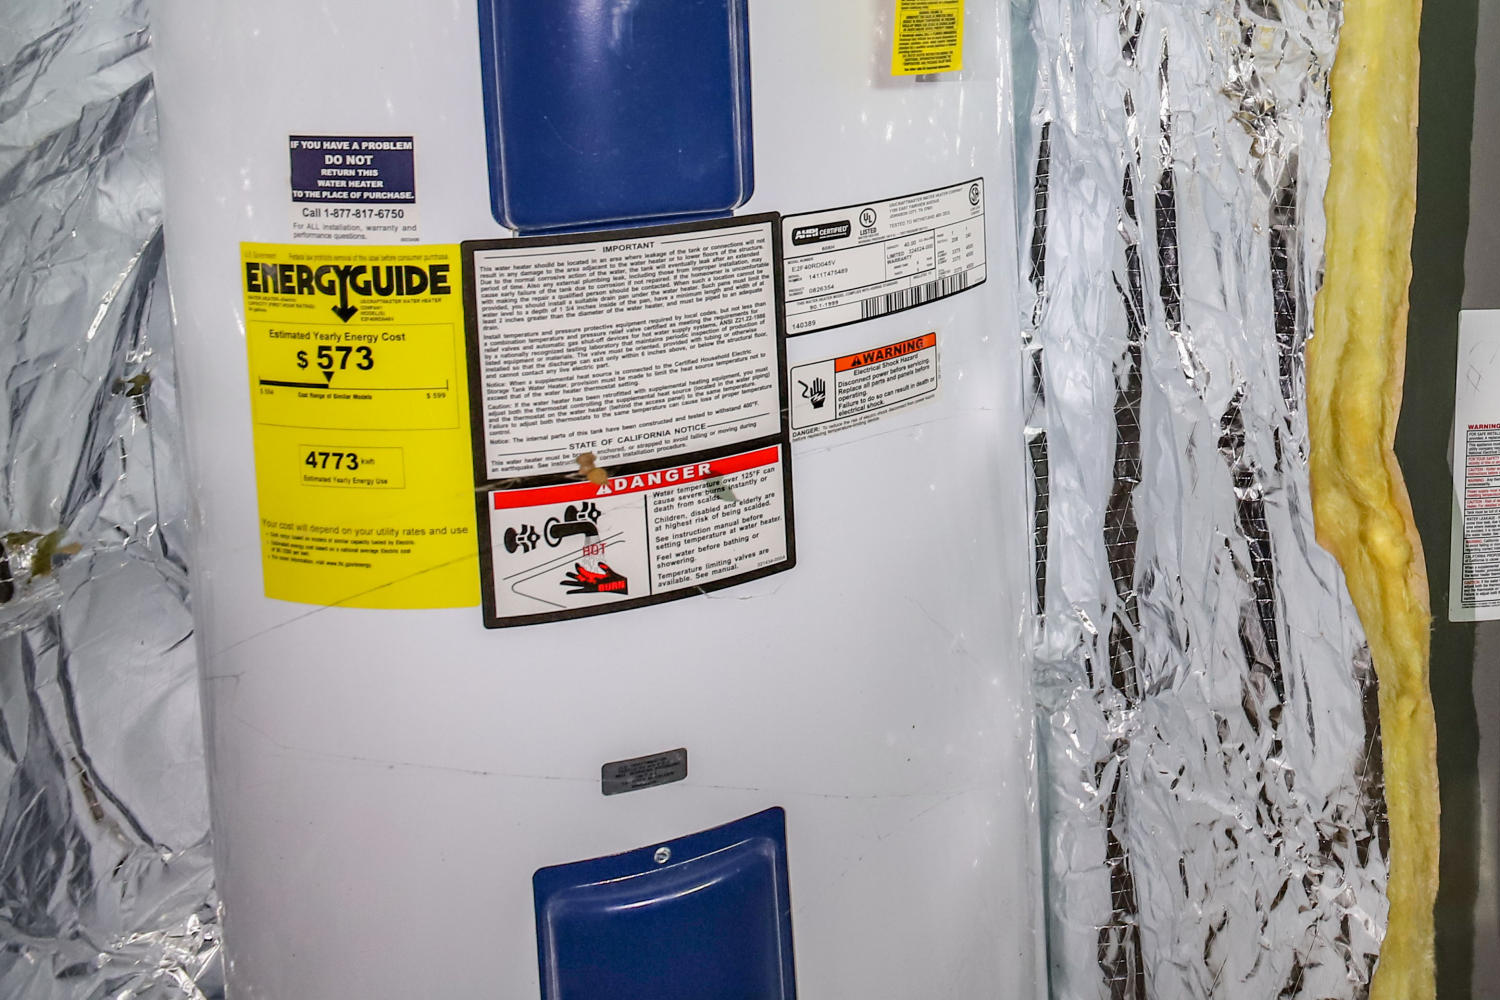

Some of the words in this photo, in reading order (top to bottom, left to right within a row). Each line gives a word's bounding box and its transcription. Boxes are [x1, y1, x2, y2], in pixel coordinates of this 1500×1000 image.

[291, 141, 299, 149] IF
[301, 141, 321, 149] YOU
[323, 141, 349, 149] HAVE
[362, 141, 412, 150] PROBLEM
[325, 155, 342, 165] DO
[347, 155, 373, 165] NOT
[293, 190, 303, 198] TO
[350, 191, 362, 199] OF
[363, 191, 415, 199] PURCHASE.
[349, 180, 383, 188] HEATER
[302, 208, 321, 218] Call
[324, 208, 404, 219] 1-877-817-6750
[307, 223, 320, 231] ALL
[366, 224, 398, 232] warranty
[602, 242, 655, 253] IMPORTANT
[246, 263, 451, 296] ENERGYGUIDE
[269, 329, 310, 339] Estimated
[313, 331, 341, 342] Yearly
[344, 332, 378, 343] Energy
[382, 332, 405, 341] Cost
[297, 351, 309, 370] $
[317, 346, 374, 370] 573
[863, 339, 923, 363] WARNING
[838, 376, 871, 387] Disconnect
[872, 371, 888, 381] power
[890, 367, 906, 375] before
[908, 359, 929, 371] servicing
[854, 364, 881, 376] Electrical
[882, 359, 899, 369] Shock
[900, 353, 918, 363] Hazard
[838, 385, 862, 395] Replace
[871, 378, 885, 387] parts
[898, 370, 914, 380] panels
[915, 365, 929, 373] before
[838, 398, 858, 409] Failure
[894, 385, 909, 394] result
[916, 378, 929, 387] death
[838, 391, 867, 401] operating.
[838, 404, 866, 416] electrical
[867, 400, 885, 409] shock.
[569, 440, 597, 450] STATE
[617, 430, 671, 444] CALIFORNIA
[675, 423, 706, 434] NOTICE
[792, 427, 820, 438] DANGER:
[305, 451, 359, 470] 4773
[613, 463, 712, 491] DANGER
[653, 490, 674, 498] Water
[677, 480, 720, 495] temperature
[723, 476, 738, 484] over
[654, 497, 674, 505] cause
[705, 487, 725, 495] burns
[728, 478, 757, 490] instantly
[654, 505, 674, 513] death
[654, 514, 687, 524] Children,
[691, 506, 720, 517] disabled
[724, 502, 736, 510] and
[739, 496, 762, 506] elderly
[665, 520, 692, 531] highest
[695, 515, 708, 523] risk
[722, 508, 741, 518] being
[744, 501, 771, 512] scalded.
[279, 521, 294, 530] cost
[310, 524, 339, 535] depend
[355, 528, 374, 537] your
[376, 527, 400, 537] utility
[403, 527, 426, 536] rates
[429, 527, 448, 535] and
[451, 527, 468, 535] use
[656, 540, 681, 551] setting
[684, 531, 726, 545] temperature
[760, 515, 782, 526] heater.
[672, 527, 711, 540] instruction
[714, 520, 739, 530] manual
[742, 513, 763, 523] before
[583, 543, 606, 556] HOT
[657, 553, 672, 561] Feel
[698, 543, 720, 553] before
[723, 536, 749, 547] bathing
[657, 557, 696, 568] showering.
[658, 566, 703, 580] Temperature
[705, 559, 731, 570] limiting
[735, 553, 756, 561] valves
[597, 580, 625, 592] BURN
[658, 576, 692, 587] available.
[696, 571, 708, 579] See
[712, 564, 739, 575] manual.
